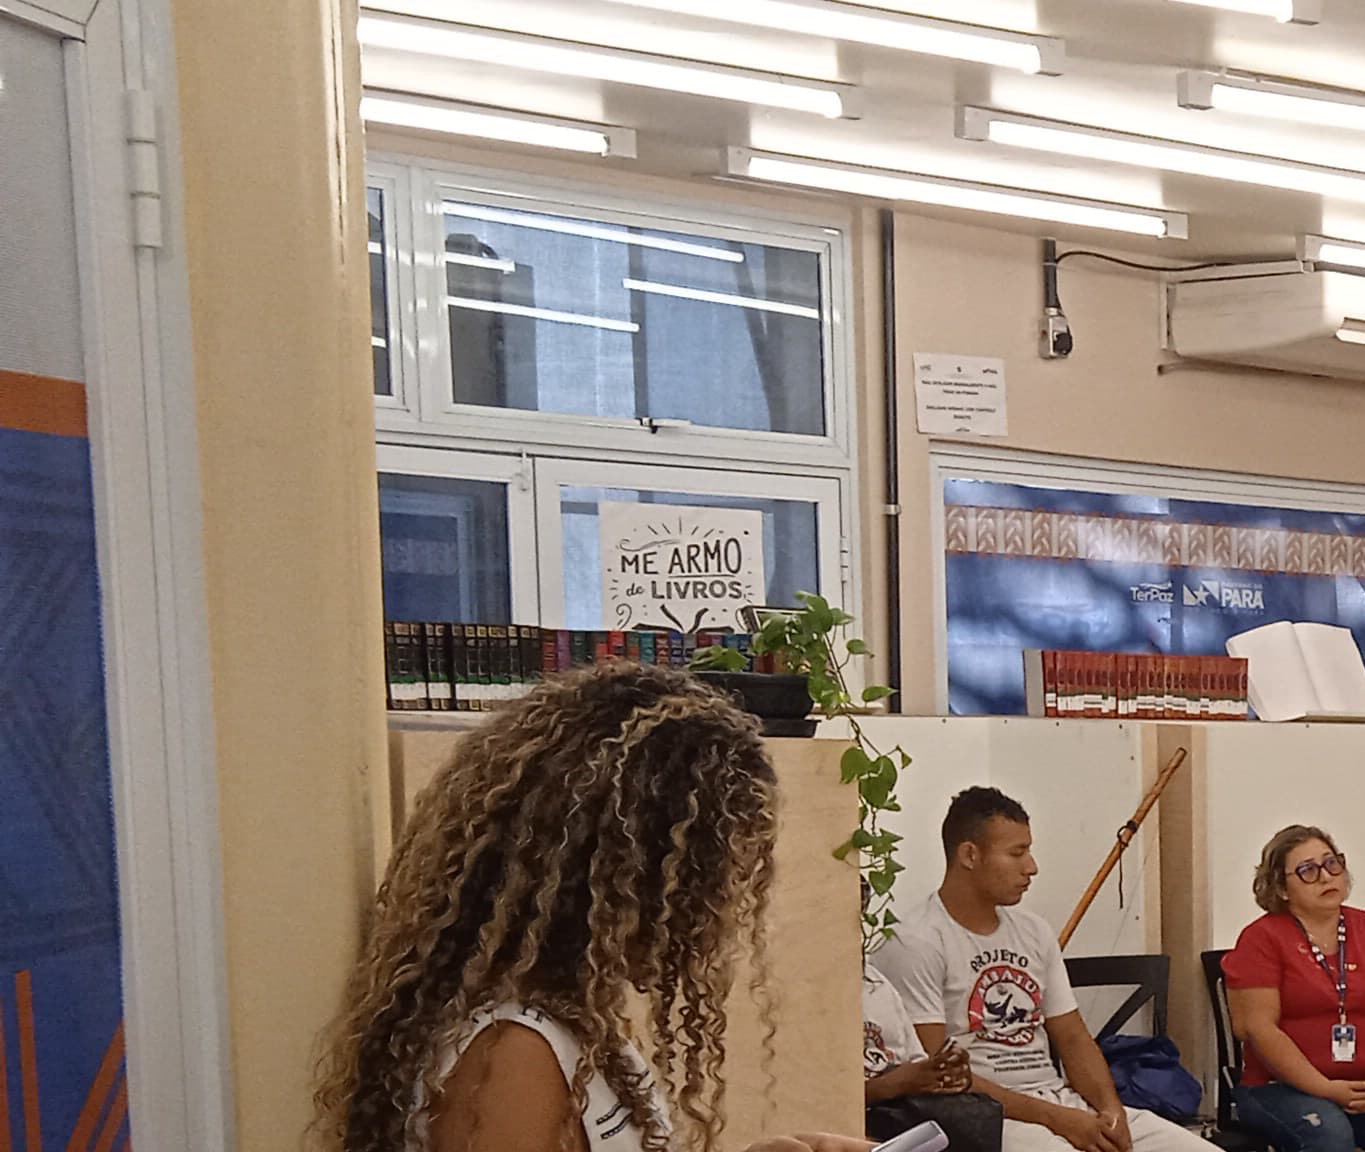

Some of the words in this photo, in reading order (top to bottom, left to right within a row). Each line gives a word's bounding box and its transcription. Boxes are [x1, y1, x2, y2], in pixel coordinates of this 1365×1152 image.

[620, 552, 659, 575] ME
[668, 537, 742, 575] ARMO
[626, 583, 644, 597] de
[651, 580, 742, 600] LIVROS
[1130, 586, 1173, 602] TerPaz
[970, 949, 1029, 973] PROJETO
